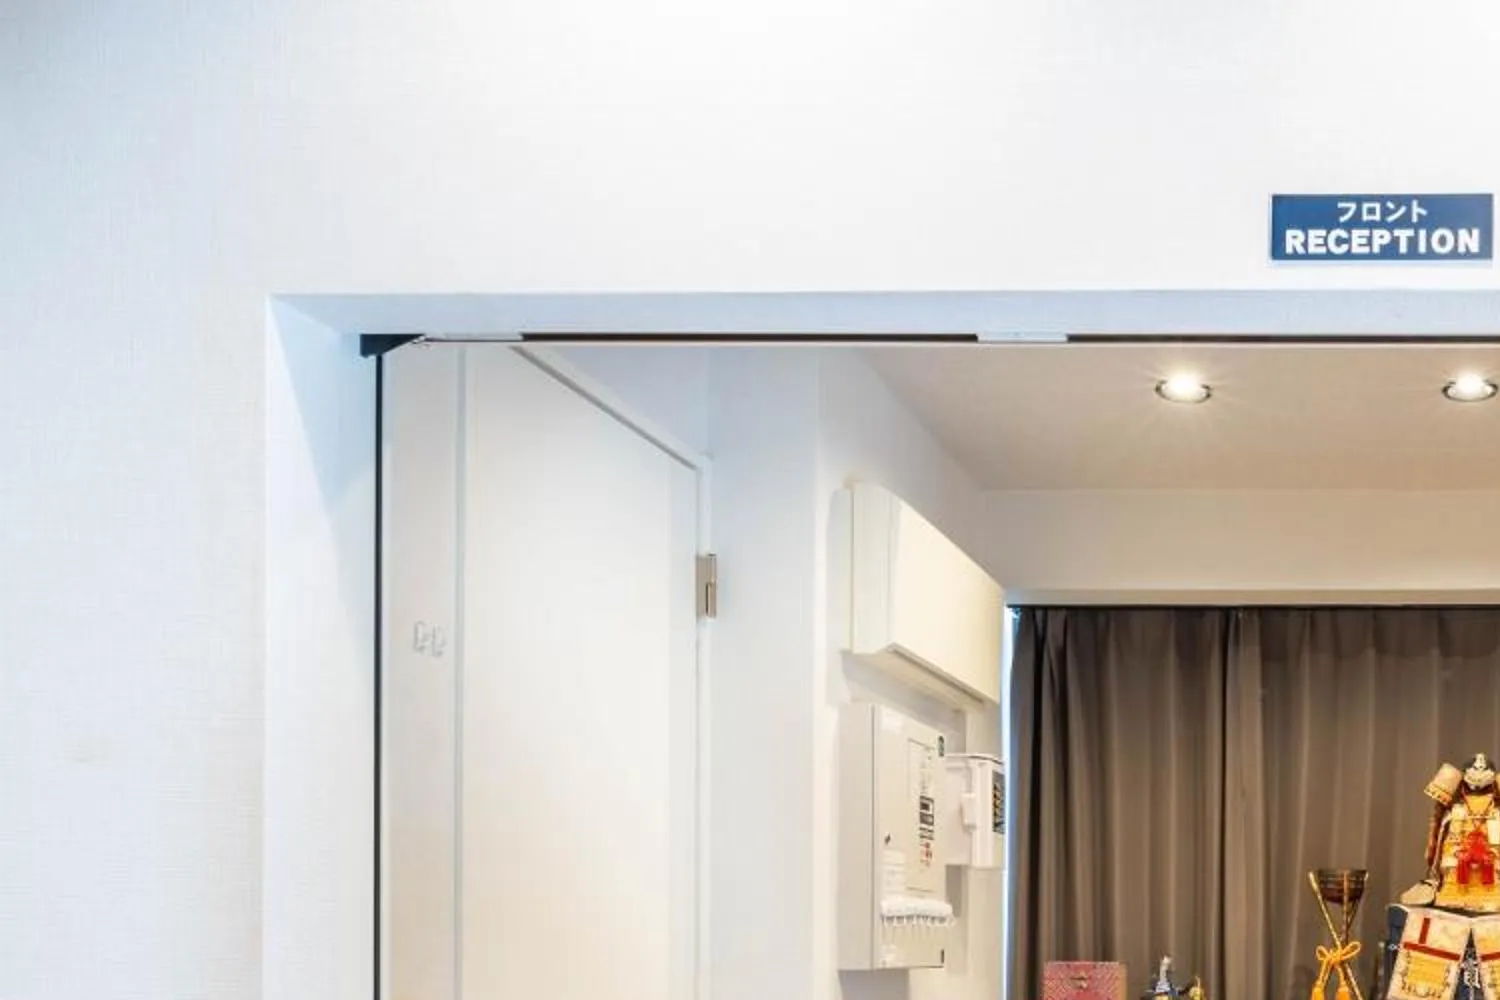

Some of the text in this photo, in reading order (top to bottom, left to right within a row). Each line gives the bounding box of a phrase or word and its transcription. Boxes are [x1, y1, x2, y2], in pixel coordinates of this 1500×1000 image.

[1336, 199, 1429, 224] フロント
[1284, 228, 1481, 255] RECEPTION
